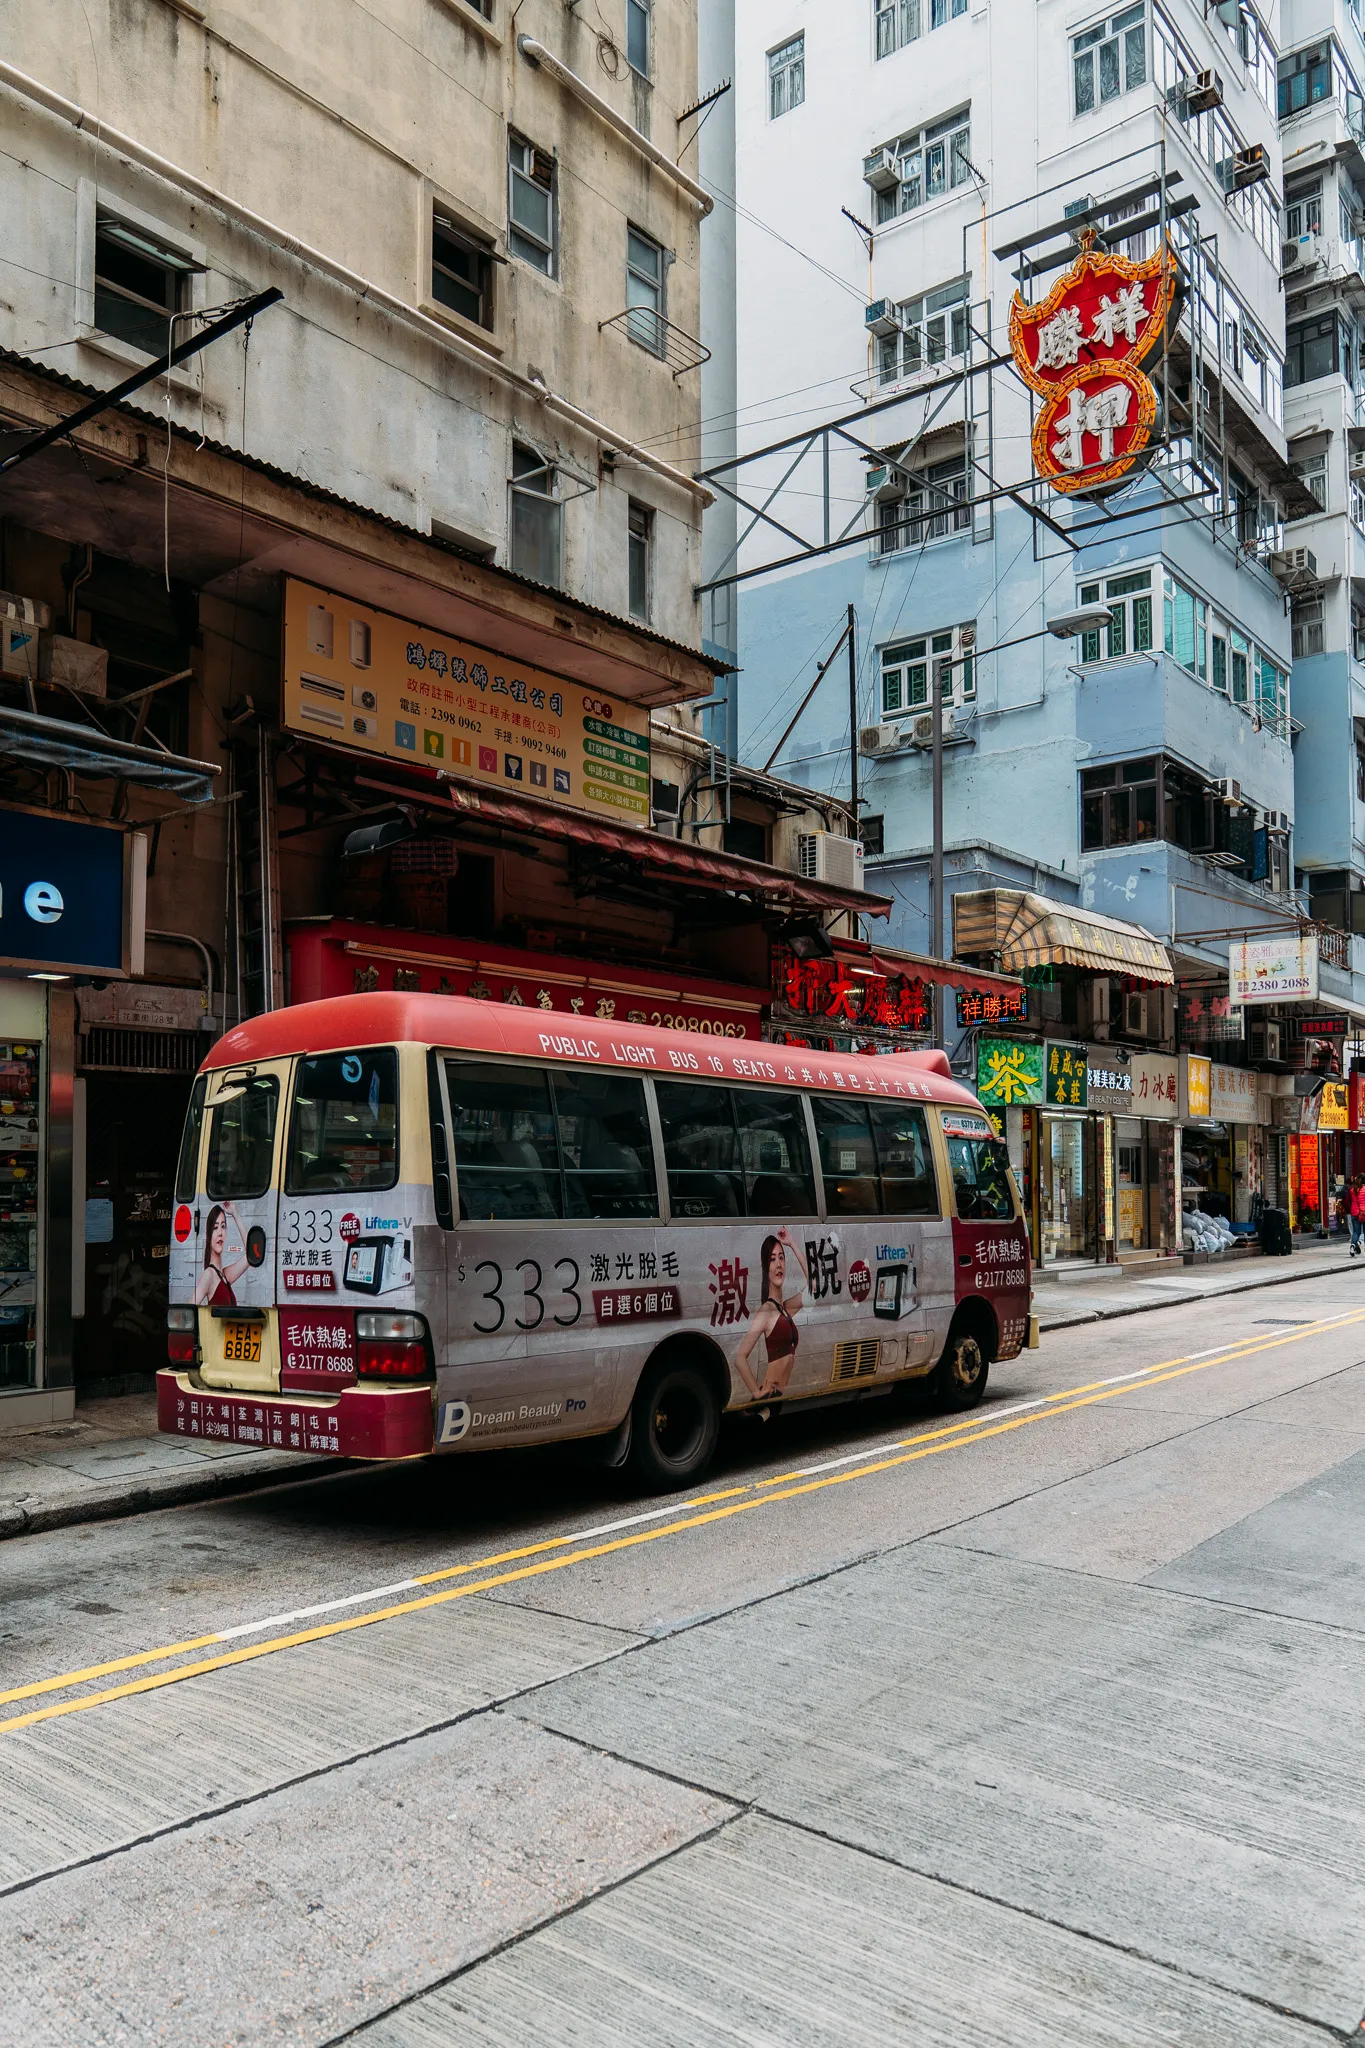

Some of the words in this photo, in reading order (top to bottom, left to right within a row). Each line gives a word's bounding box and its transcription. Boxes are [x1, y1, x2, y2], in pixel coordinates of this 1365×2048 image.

[1050, 381, 1132, 469] 押
[406, 641, 564, 717] 鴻輝裝飾工程公司
[431, 707, 456, 727] 2398
[458, 713, 482, 735] 0962
[521, 735, 543, 753] 9092
[545, 740, 567, 760] 9460
[1251, 980, 1278, 992] 2380
[1281, 977, 1309, 989] 2088
[538, 1034, 600, 1058] PUBLIC
[610, 1043, 656, 1065] LIGHT
[668, 1050, 699, 1070] BUS
[708, 1056, 724, 1072] 16
[732, 1058, 776, 1078] SEATS
[784, 1065, 933, 1097] 公共小型巴士十六座位
[980, 1046, 1040, 1105] 茶
[1132, 1072, 1177, 1103] 力冰廳
[340, 1219, 358, 1230] FREE
[366, 1216, 412, 1230] Liftera-V
[282, 1249, 333, 1266] 激光脫毛
[876, 1244, 915, 1260] Liftera-V
[590, 1251, 680, 1283] 激光脫毛
[286, 1273, 332, 1288] 自選6個位
[849, 1270, 867, 1285] FREE
[984, 1270, 1004, 1287] 2177
[1005, 1269, 1025, 1285] 8688
[600, 1292, 674, 1318] 自選6個位
[236, 1325, 252, 1342] EA
[226, 1341, 260, 1361] 6887
[299, 1354, 324, 1371] 2177
[327, 1354, 353, 1372] 8688
[472, 1410, 515, 1427] Dream
[519, 1402, 562, 1419] Beauty
[565, 1399, 587, 1412] Pro
[472, 1418, 562, 1438] www.dreambeautypro.com
